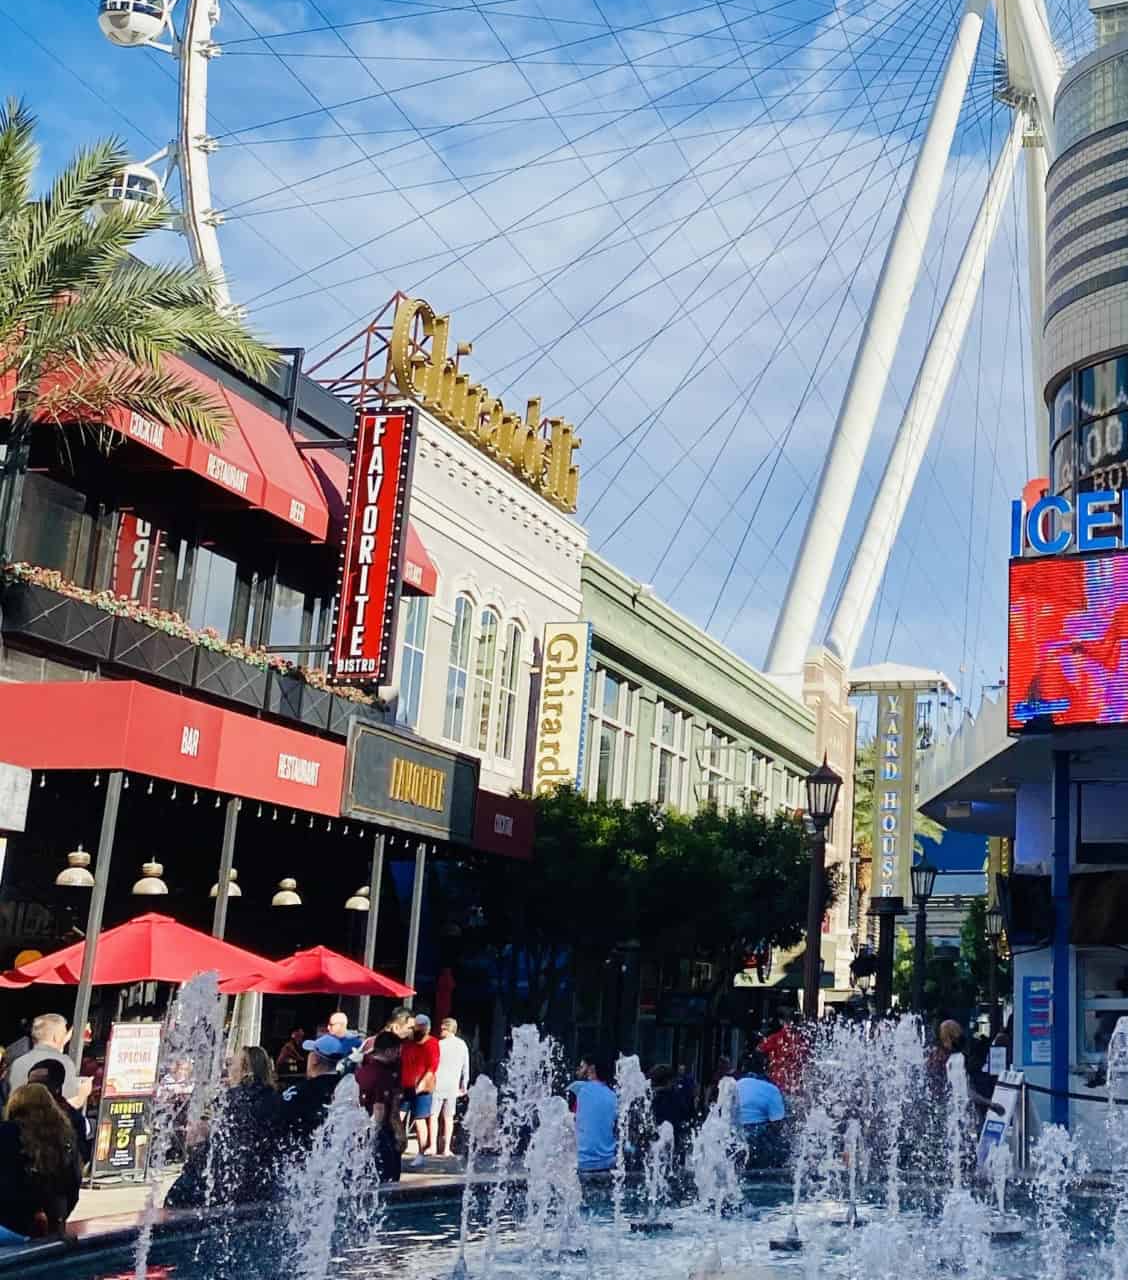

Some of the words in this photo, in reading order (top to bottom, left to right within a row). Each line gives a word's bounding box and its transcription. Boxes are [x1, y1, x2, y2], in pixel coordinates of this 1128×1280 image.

[207, 453, 248, 494] RESTAURANT
[350, 416, 387, 657] FAVORITE
[336, 658, 376, 674] BISTRO
[180, 726, 200, 757] BAR
[885, 695, 900, 780] YARD
[277, 752, 320, 787] RESTAURANT
[881, 792, 897, 897] HOUSE
